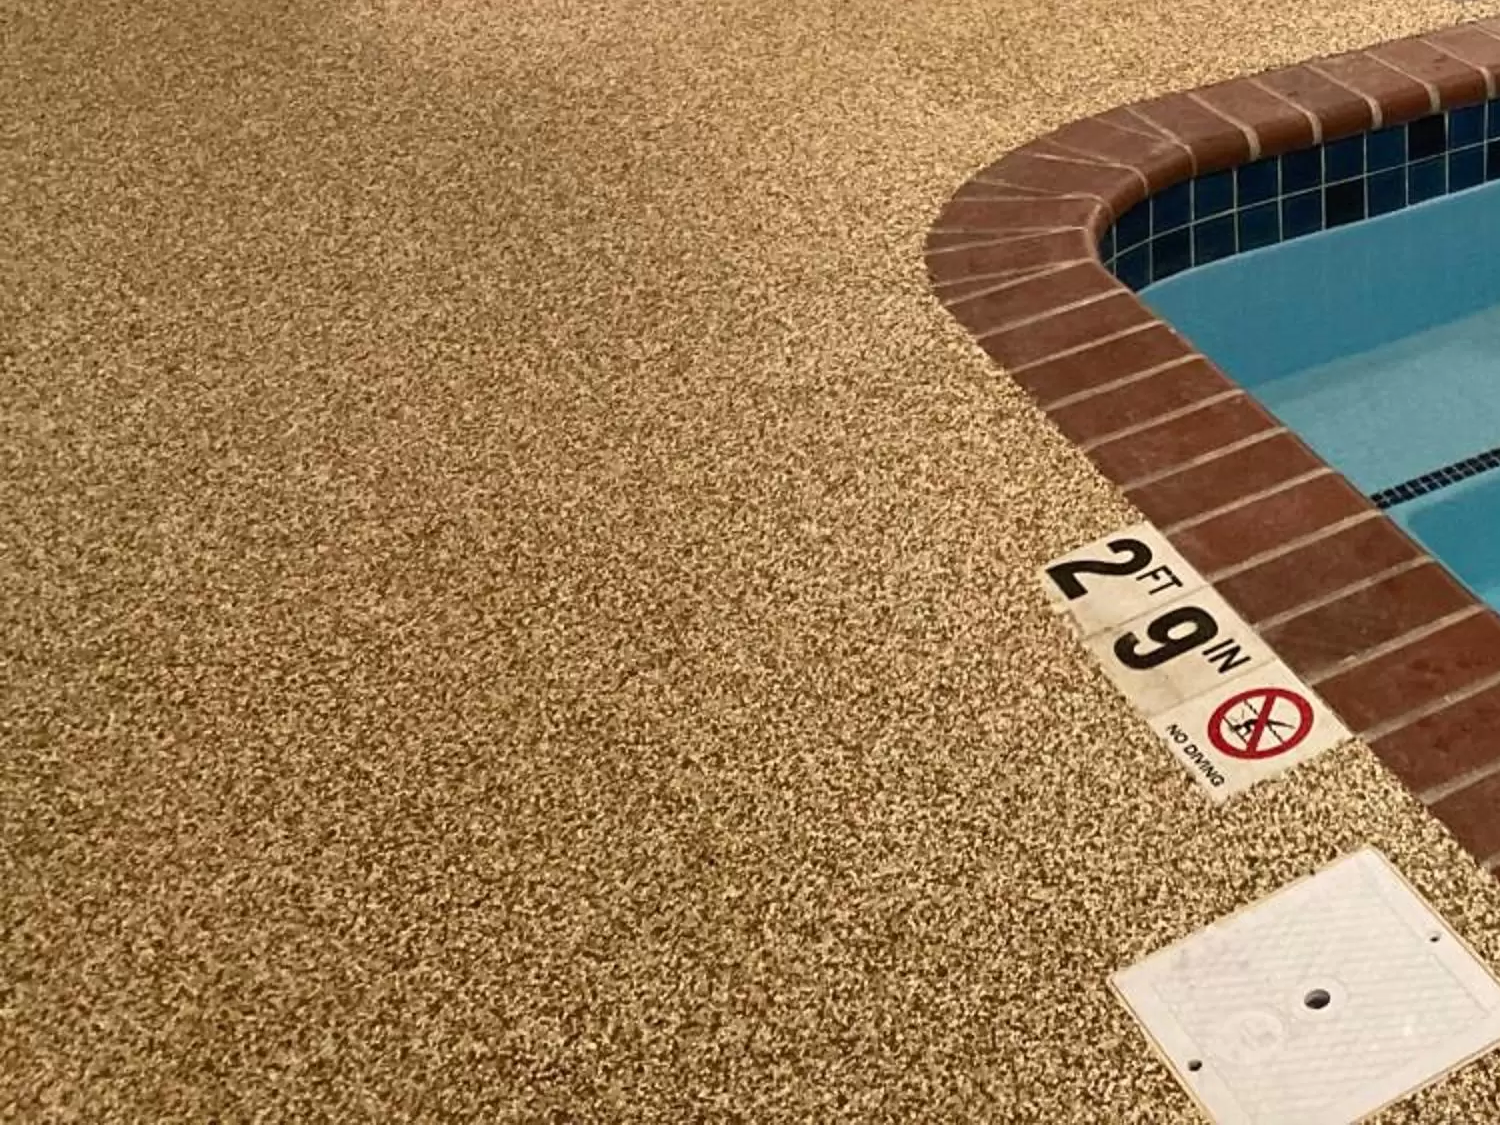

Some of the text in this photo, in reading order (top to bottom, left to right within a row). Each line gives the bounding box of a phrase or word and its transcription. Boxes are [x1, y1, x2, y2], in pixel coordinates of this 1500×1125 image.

[1045, 538, 1251, 674] 2 FT 9 IN
[1167, 722, 1226, 789] NO DIVING
